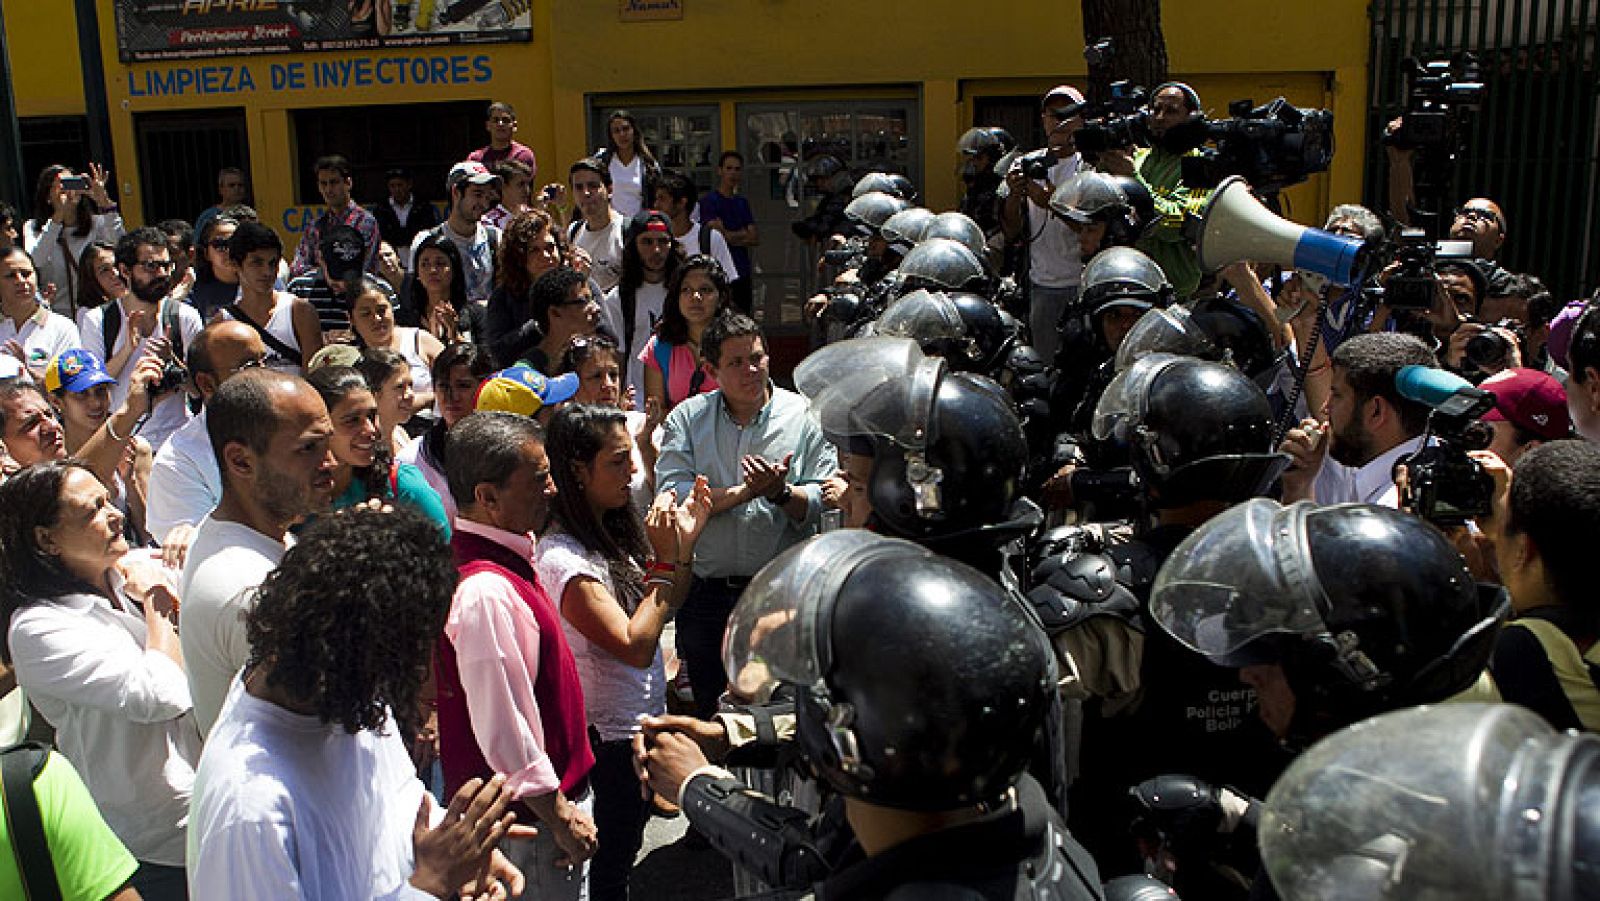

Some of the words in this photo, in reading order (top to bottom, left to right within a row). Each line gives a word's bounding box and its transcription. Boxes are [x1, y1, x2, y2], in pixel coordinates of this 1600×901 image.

[181, 29, 249, 43] Performance
[252, 24, 290, 40] Street
[128, 65, 256, 97] LIMPIEZA
[270, 61, 306, 92] DE
[313, 55, 493, 88] INYECTORES
